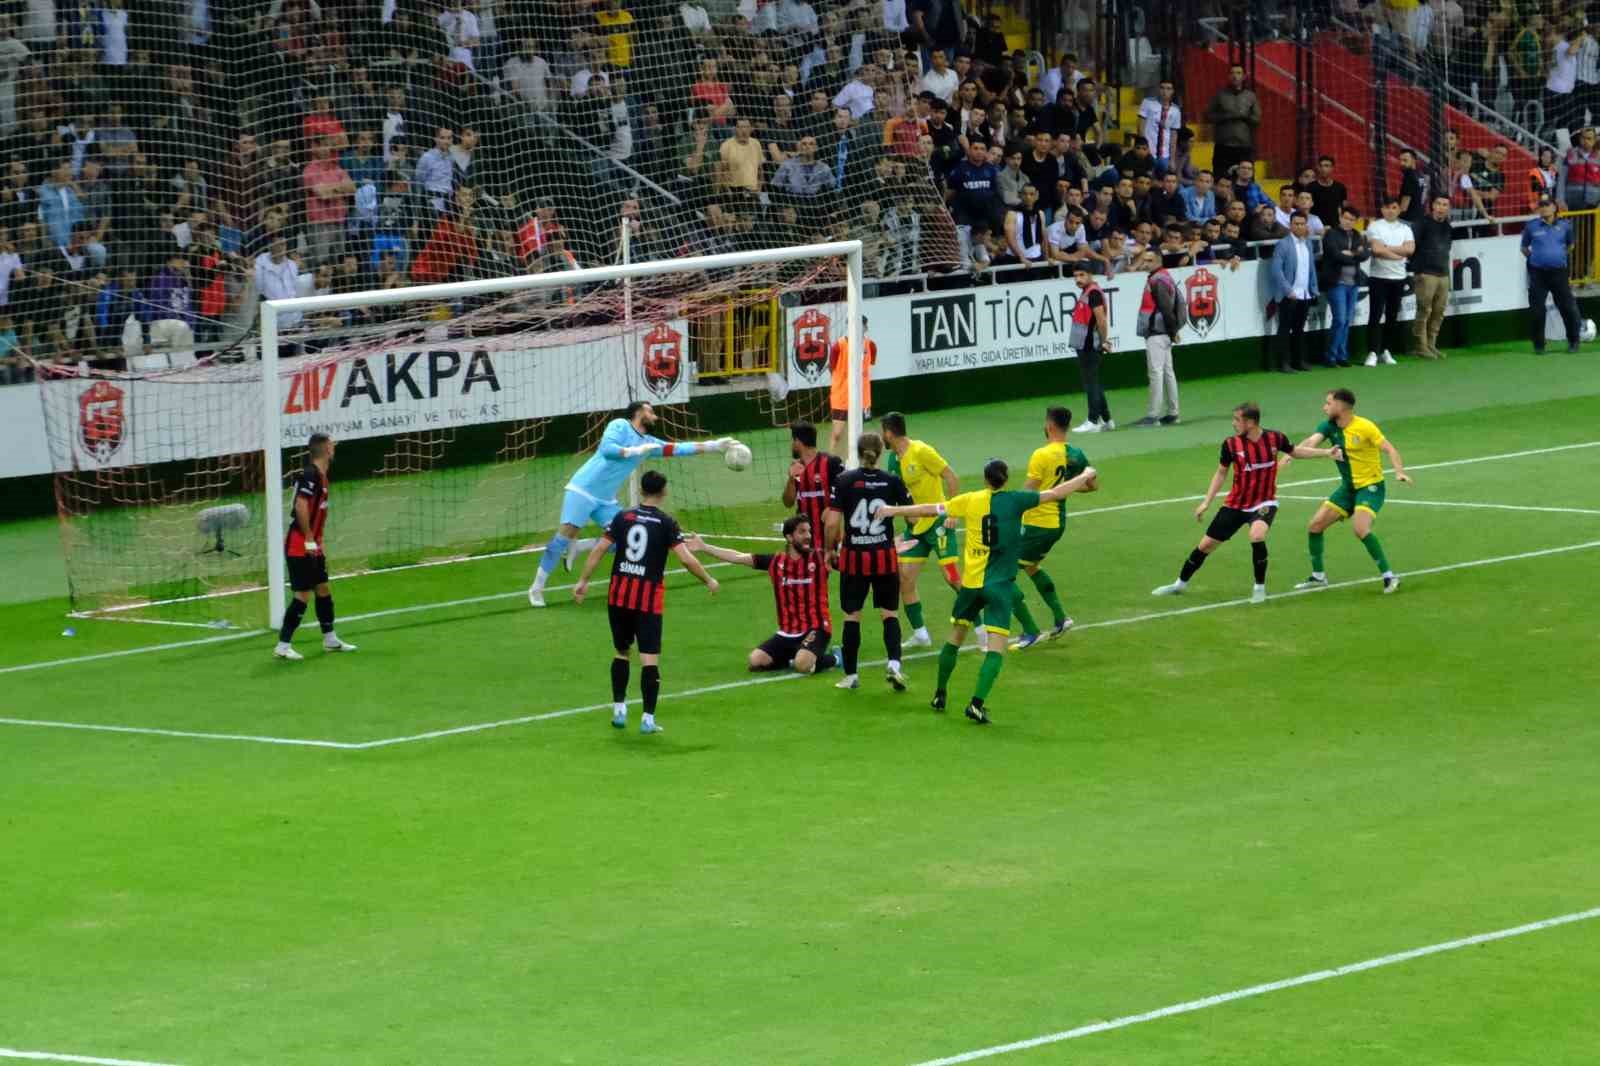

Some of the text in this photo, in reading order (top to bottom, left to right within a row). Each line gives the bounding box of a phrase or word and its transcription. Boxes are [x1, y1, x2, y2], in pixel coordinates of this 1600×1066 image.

[912, 287, 1120, 350] TAN TİCART
[915, 358, 935, 370] YAPI
[981, 350, 1001, 363] GIDA
[1003, 343, 1034, 361] ÜRETİM
[340, 346, 501, 408] AKPA
[424, 412, 439, 423] VE
[850, 498, 887, 535] 42
[625, 524, 648, 562] 9
[619, 560, 646, 576] SİNAN
